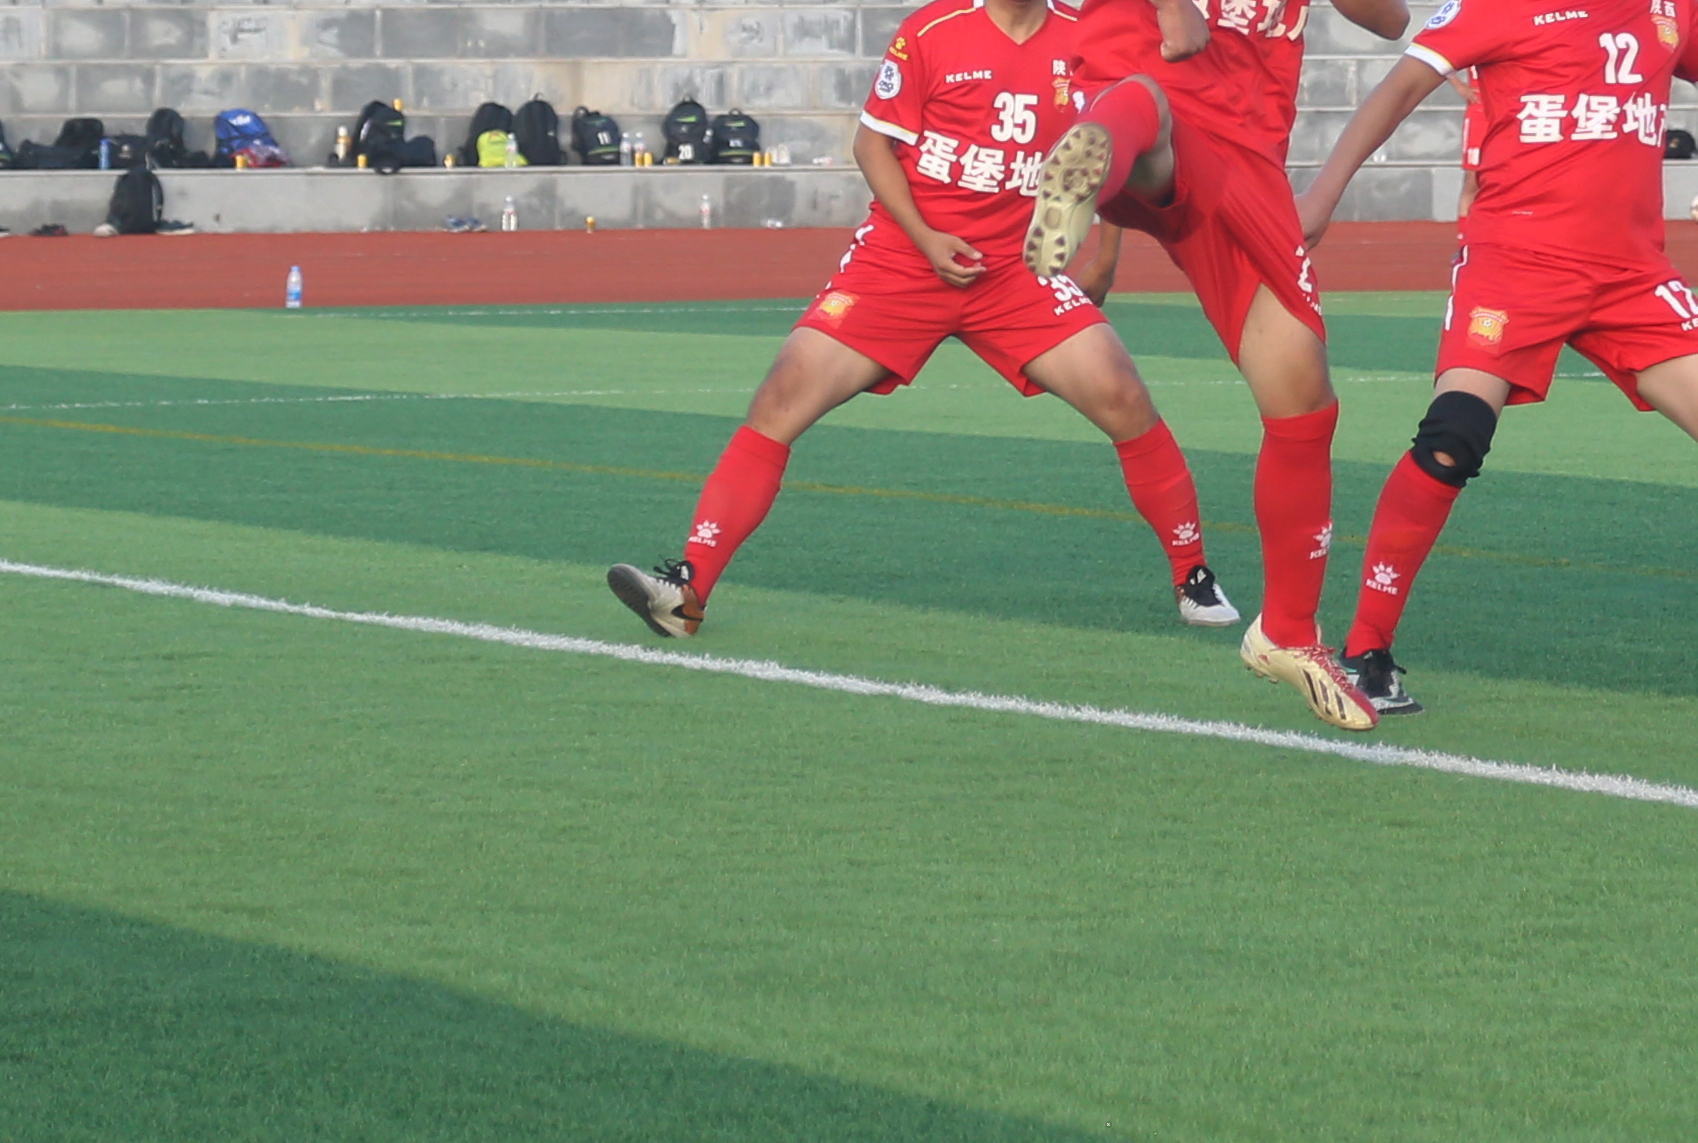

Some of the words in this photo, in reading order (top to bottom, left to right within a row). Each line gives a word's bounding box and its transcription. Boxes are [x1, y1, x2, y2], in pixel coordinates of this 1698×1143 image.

[1534, 10, 1590, 26] KELME
[1598, 32, 1644, 84] 12
[946, 70, 992, 84] KELME
[991, 91, 1038, 145] 35
[1366, 578, 1398, 595] KELME
